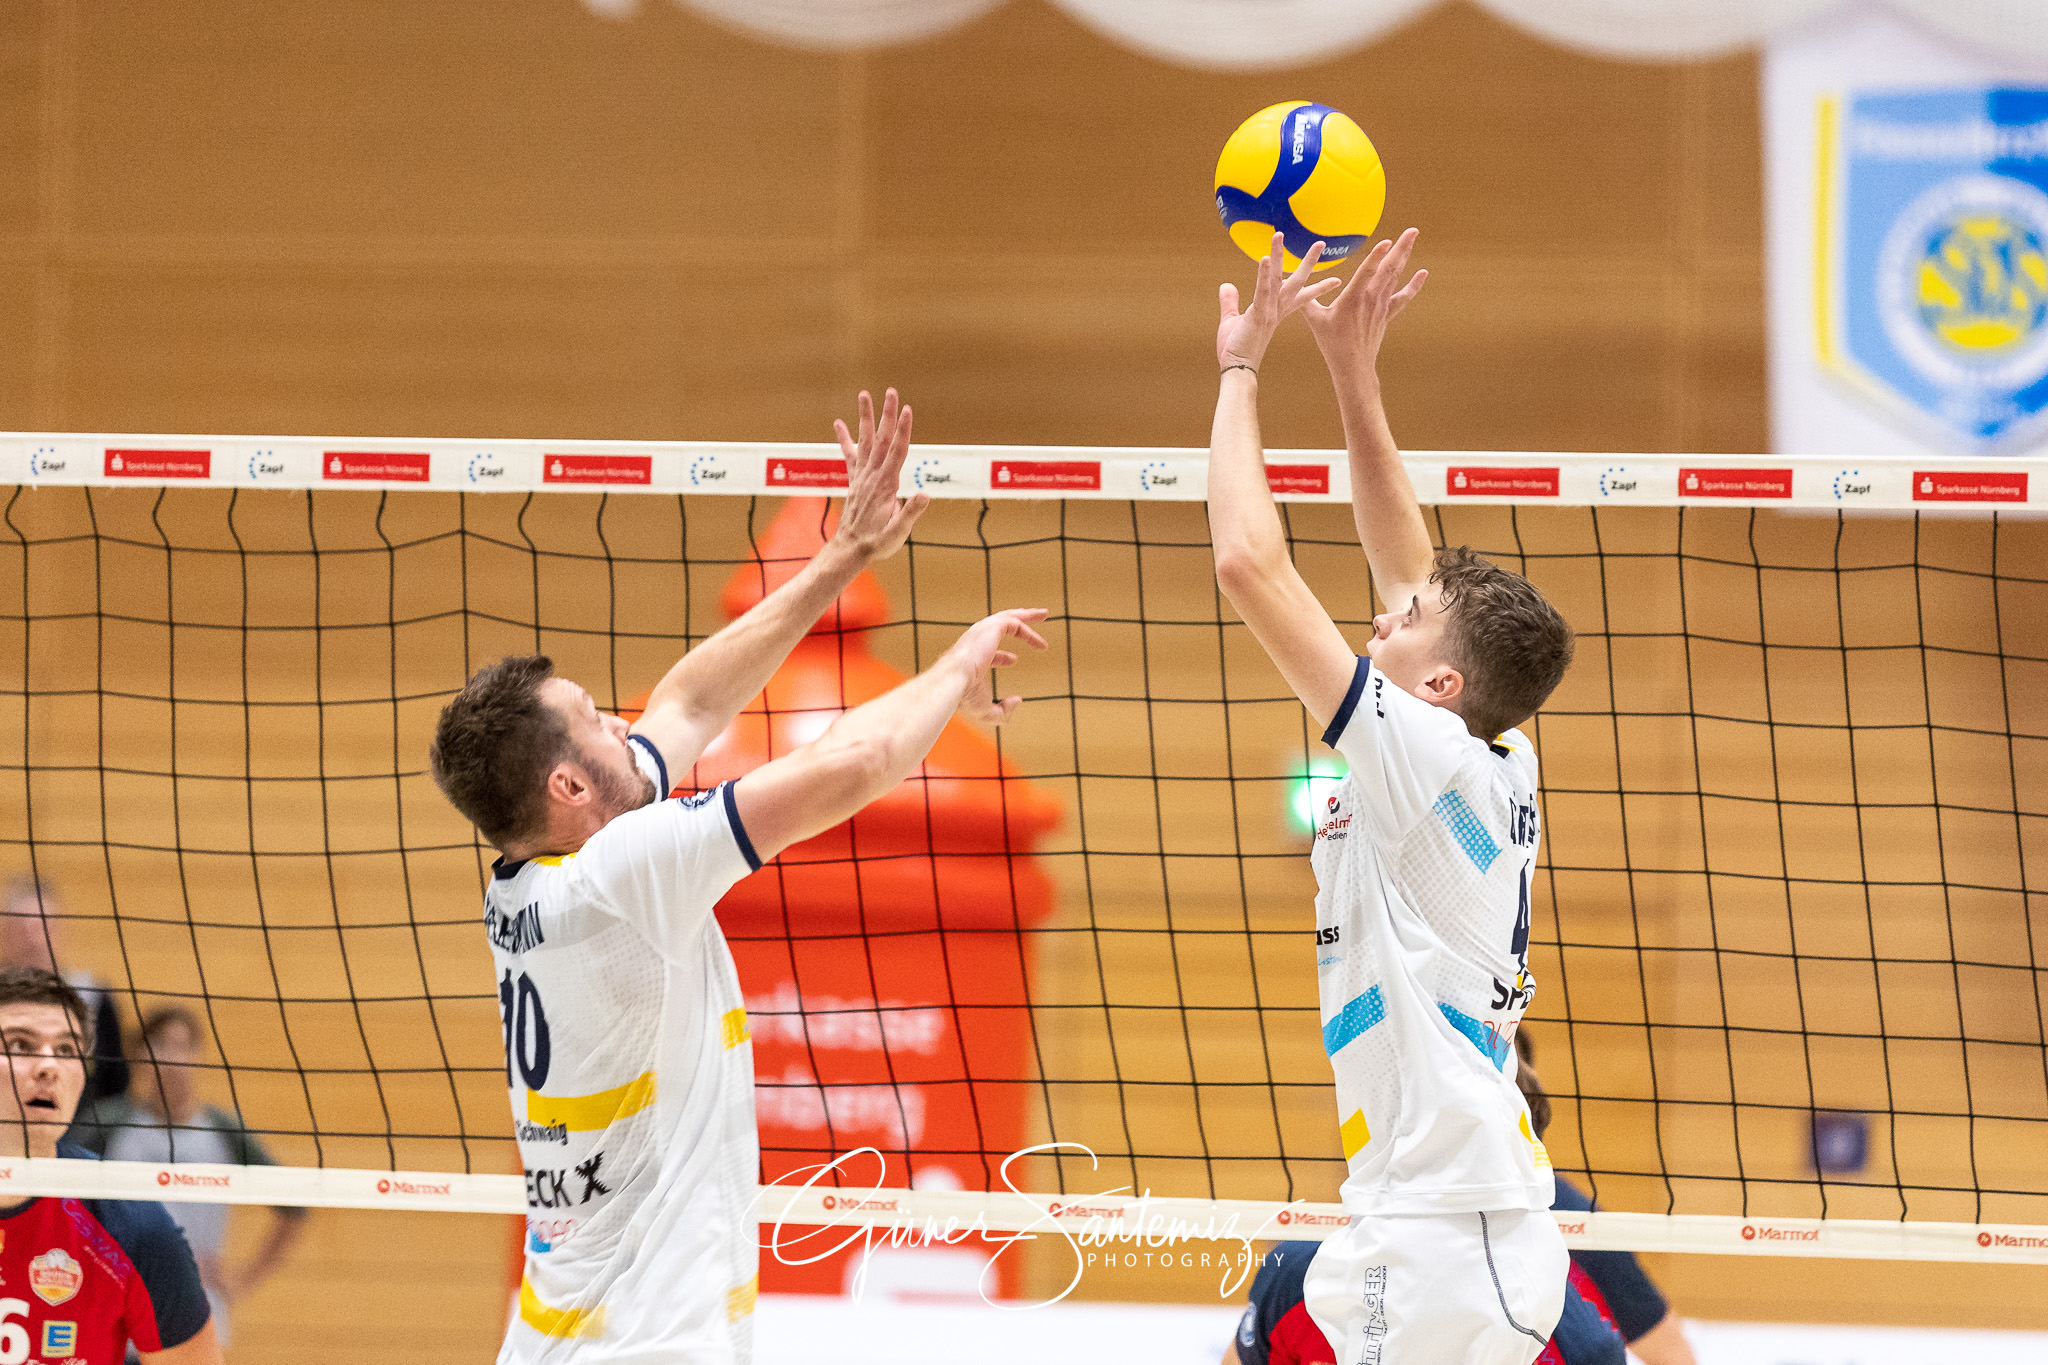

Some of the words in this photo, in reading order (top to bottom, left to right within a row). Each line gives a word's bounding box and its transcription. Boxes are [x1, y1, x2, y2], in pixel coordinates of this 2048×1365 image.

[41, 460, 66, 472] Zapf
[126, 460, 165, 473] Sparkasse
[259, 463, 284, 474] Zapf
[345, 463, 384, 475] Sparkasse
[479, 466, 504, 478] Zapf
[566, 466, 605, 478] Sparkasse
[700, 469, 727, 481] Zapf
[788, 470, 828, 482] Sparkasse
[924, 473, 951, 485] Zapf
[1013, 473, 1054, 485] Sparkasse
[1151, 475, 1178, 487] Zapf
[1470, 478, 1511, 490] Sparkasse
[1610, 479, 1638, 493] Zapf
[1702, 479, 1744, 491] Sparkasse
[1844, 483, 1872, 496] Zapf
[1937, 483, 1979, 496] Sparkasse
[1327, 831, 1348, 841] edien
[500, 967, 551, 1091] 10
[173, 1172, 230, 1188] Marmot
[392, 1180, 451, 1196] Marmot
[1294, 1212, 1351, 1226] Marmo
[1758, 1226, 1820, 1243] Marmot
[1995, 1234, 2048, 1248] Marmo
[48, 1325, 71, 1347] E
